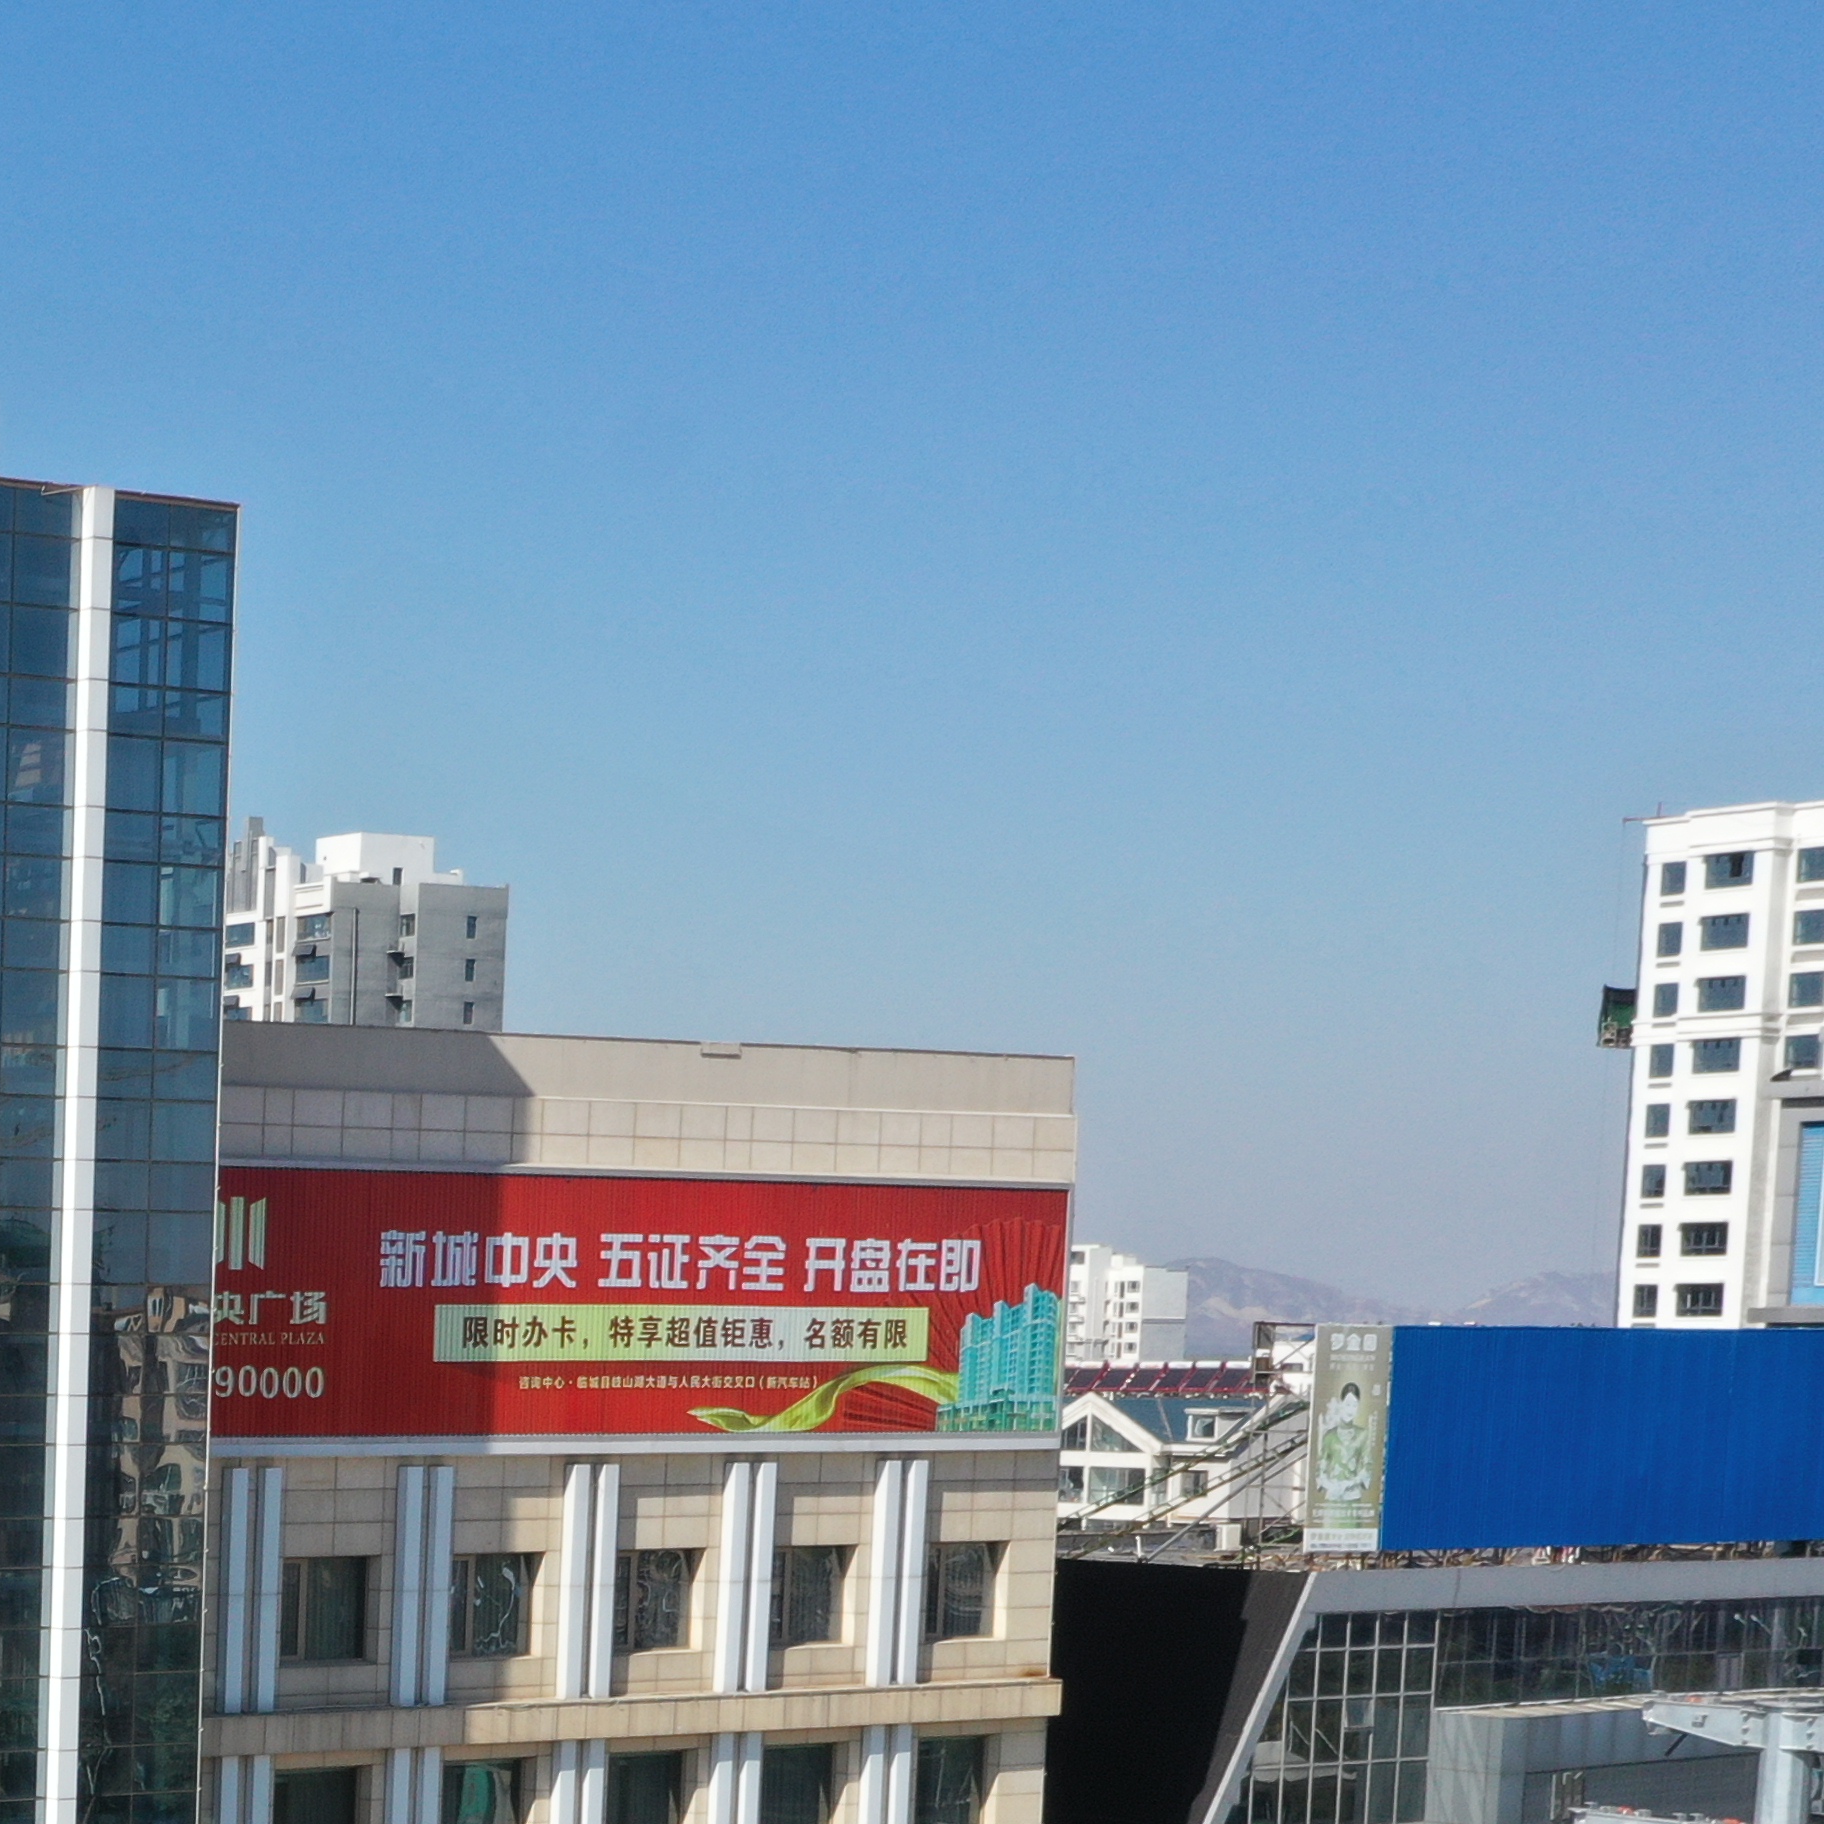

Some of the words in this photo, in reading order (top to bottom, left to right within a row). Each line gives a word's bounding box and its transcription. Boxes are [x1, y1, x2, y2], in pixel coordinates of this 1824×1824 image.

[379, 1230, 578, 1290] 新城中央
[597, 1233, 787, 1292] 五证齐全
[803, 1238, 982, 1293] 开盘在即
[281, 1332, 325, 1345] PLAZA
[215, 1365, 325, 1399] 90000
